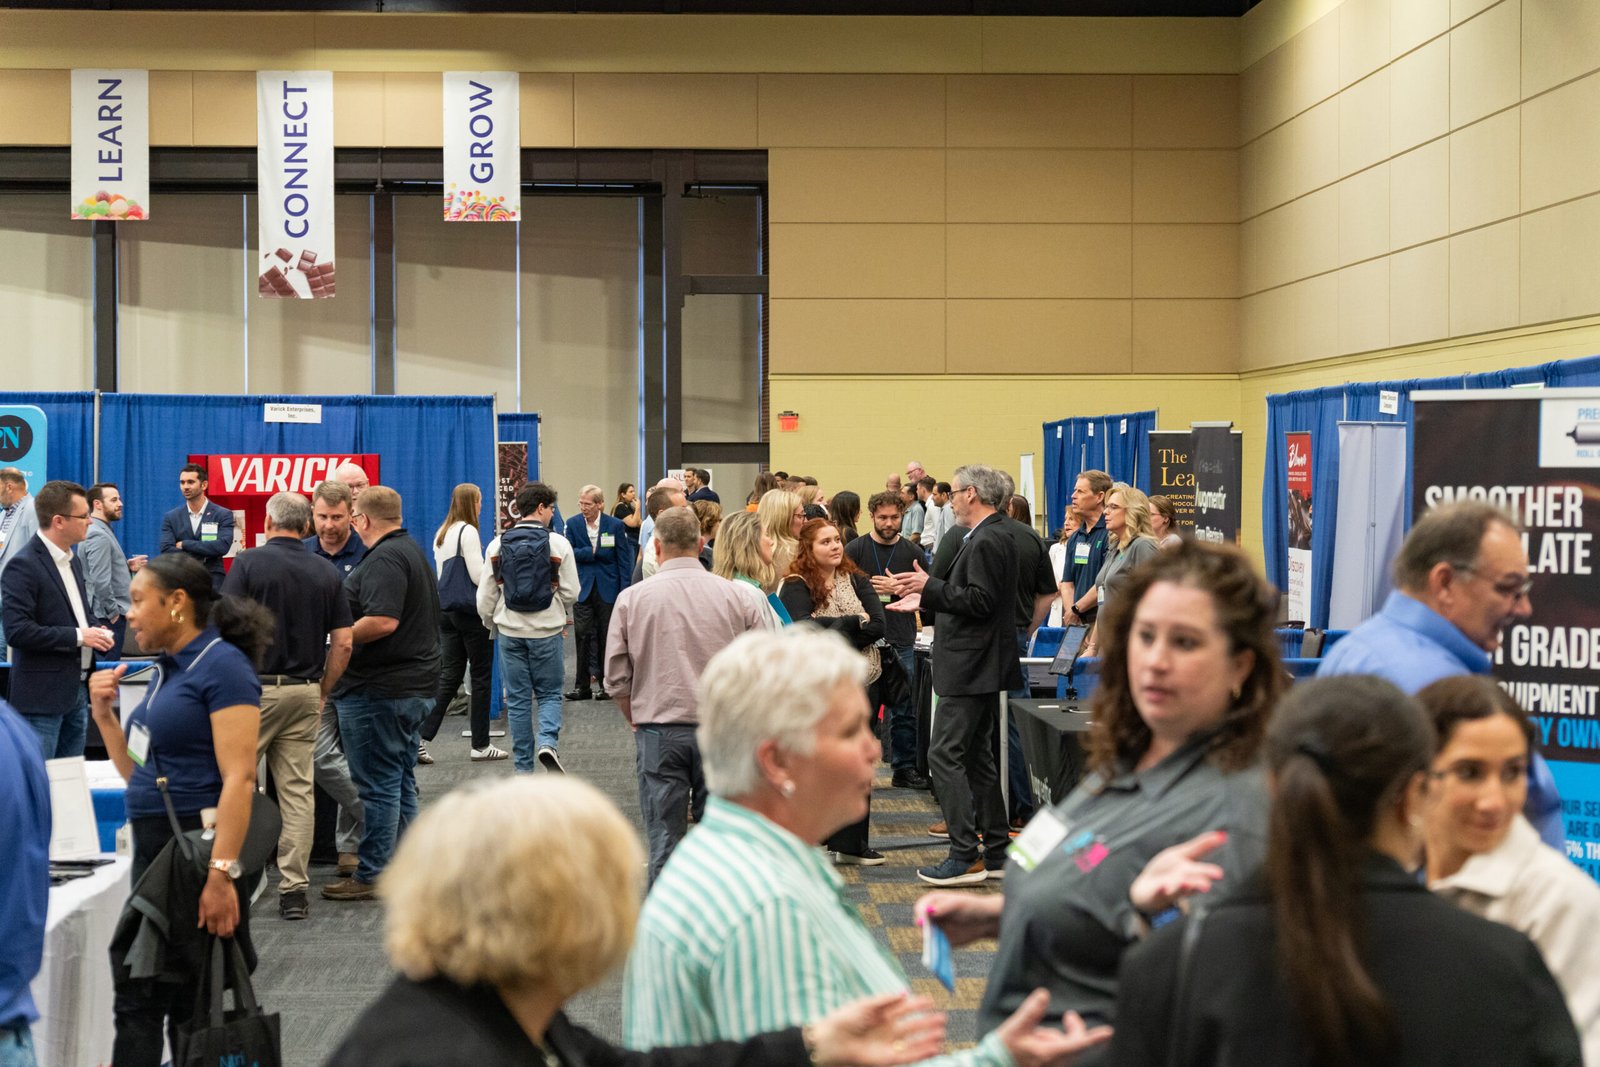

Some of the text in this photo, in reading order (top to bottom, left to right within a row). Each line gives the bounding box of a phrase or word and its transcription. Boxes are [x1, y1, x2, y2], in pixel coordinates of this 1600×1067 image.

[98, 78, 122, 182] LEARN
[283, 81, 309, 239] CONNECT
[469, 80, 493, 184] GROW
[1158, 449, 1188, 464] The
[1161, 467, 1195, 487] Lea
